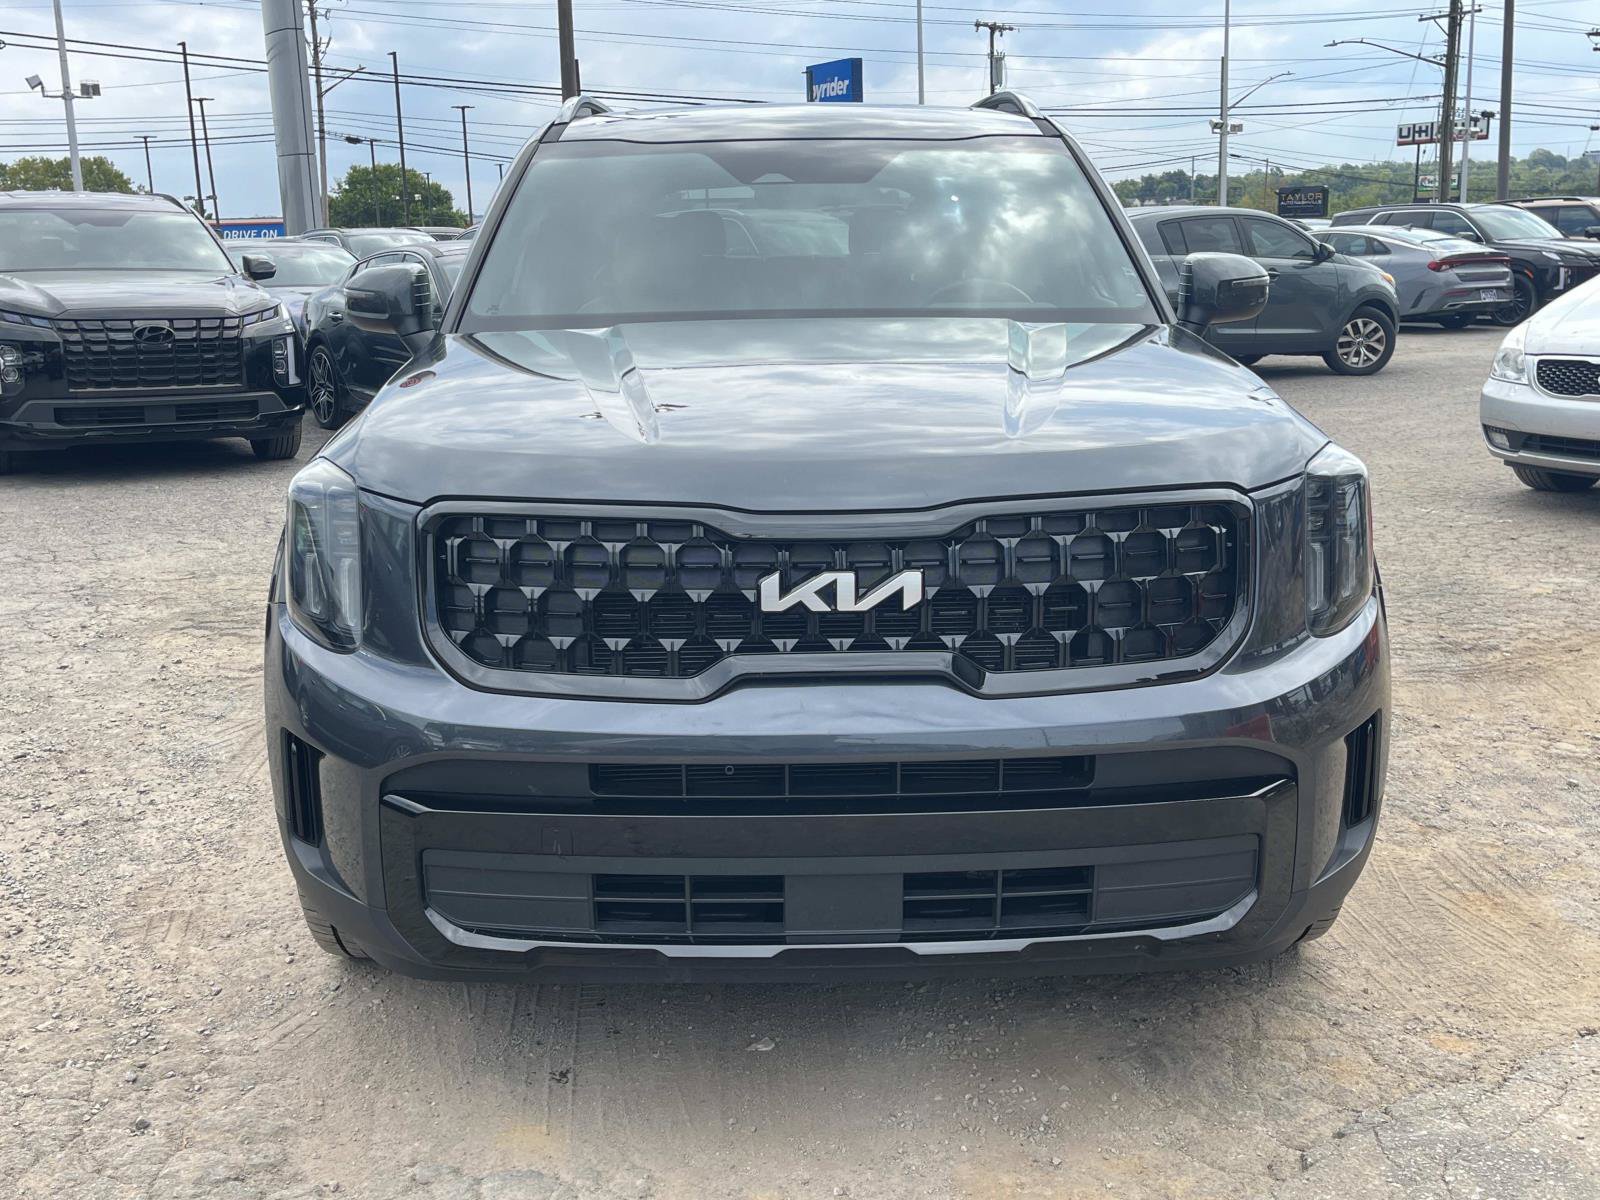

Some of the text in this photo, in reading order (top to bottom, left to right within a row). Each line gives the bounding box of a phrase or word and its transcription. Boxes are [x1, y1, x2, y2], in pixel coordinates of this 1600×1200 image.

[1281, 192, 1324, 201] TAYLOR
[223, 229, 278, 239] DRIVE ON
